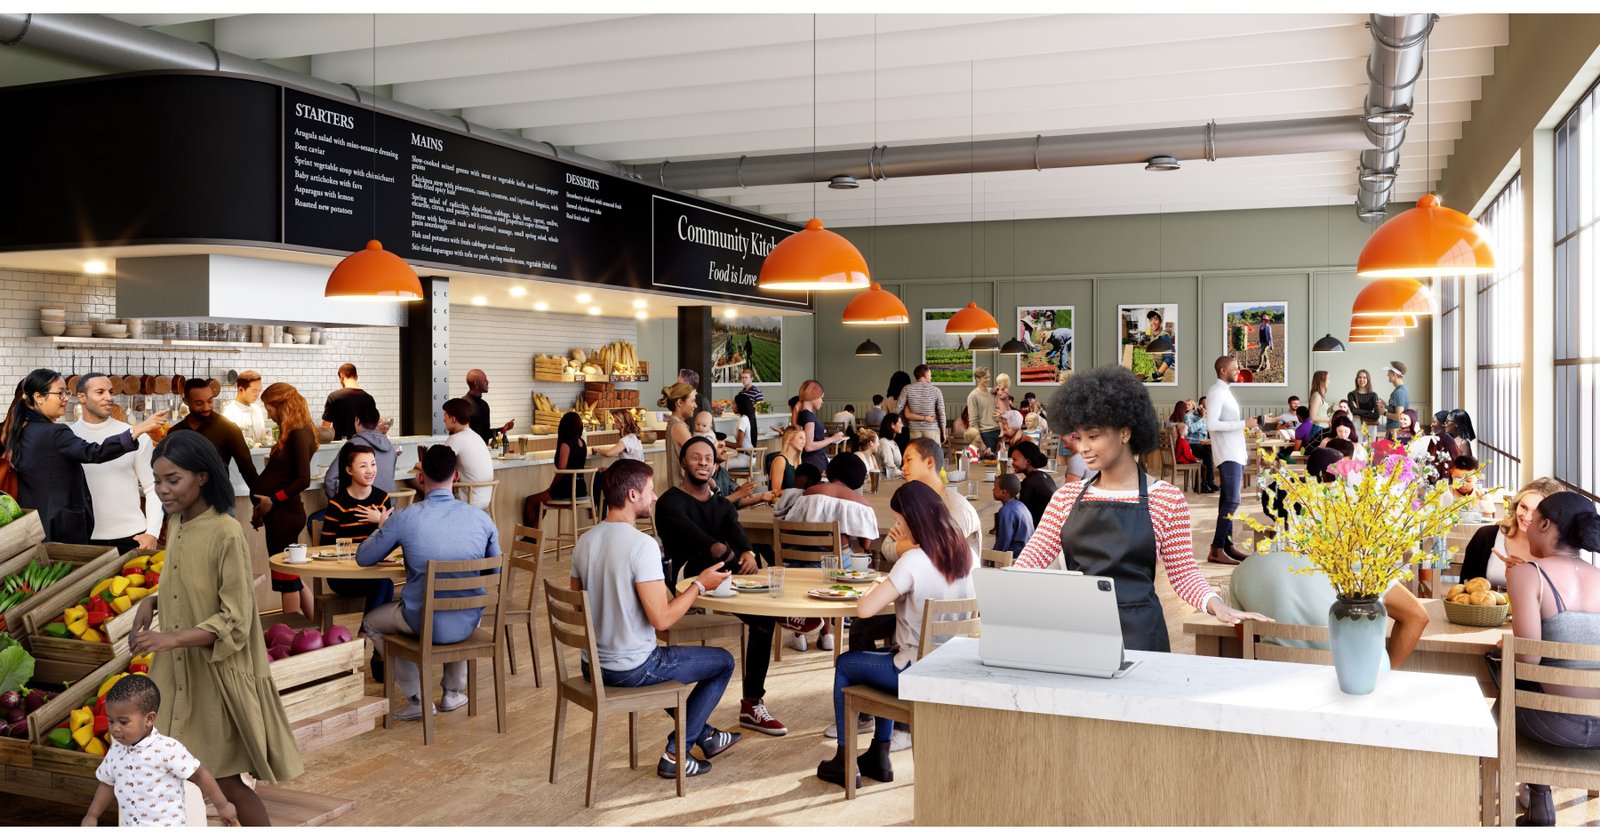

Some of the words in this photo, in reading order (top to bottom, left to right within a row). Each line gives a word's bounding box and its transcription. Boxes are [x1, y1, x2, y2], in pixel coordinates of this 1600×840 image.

[295, 102, 354, 130] STARTERS
[294, 128, 317, 140] Arugula
[318, 134, 332, 143] salad
[347, 141, 378, 153] miso-sesame
[295, 142, 307, 151] Beet
[411, 132, 443, 152] MAINS
[295, 170, 309, 181] Baby
[310, 175, 338, 185] artichokes
[314, 162, 338, 172] vegetable
[339, 168, 352, 176] soup
[366, 171, 394, 183] chimichurri
[566, 172, 600, 190] DESSERTS
[295, 185, 323, 197] Asparagus
[338, 192, 354, 201] lemon
[295, 198, 317, 209] Roasted
[678, 215, 749, 260] Community
[751, 232, 776, 257] Kitch
[708, 260, 730, 282] Food
[731, 265, 738, 283] is
[739, 267, 758, 286] Love
